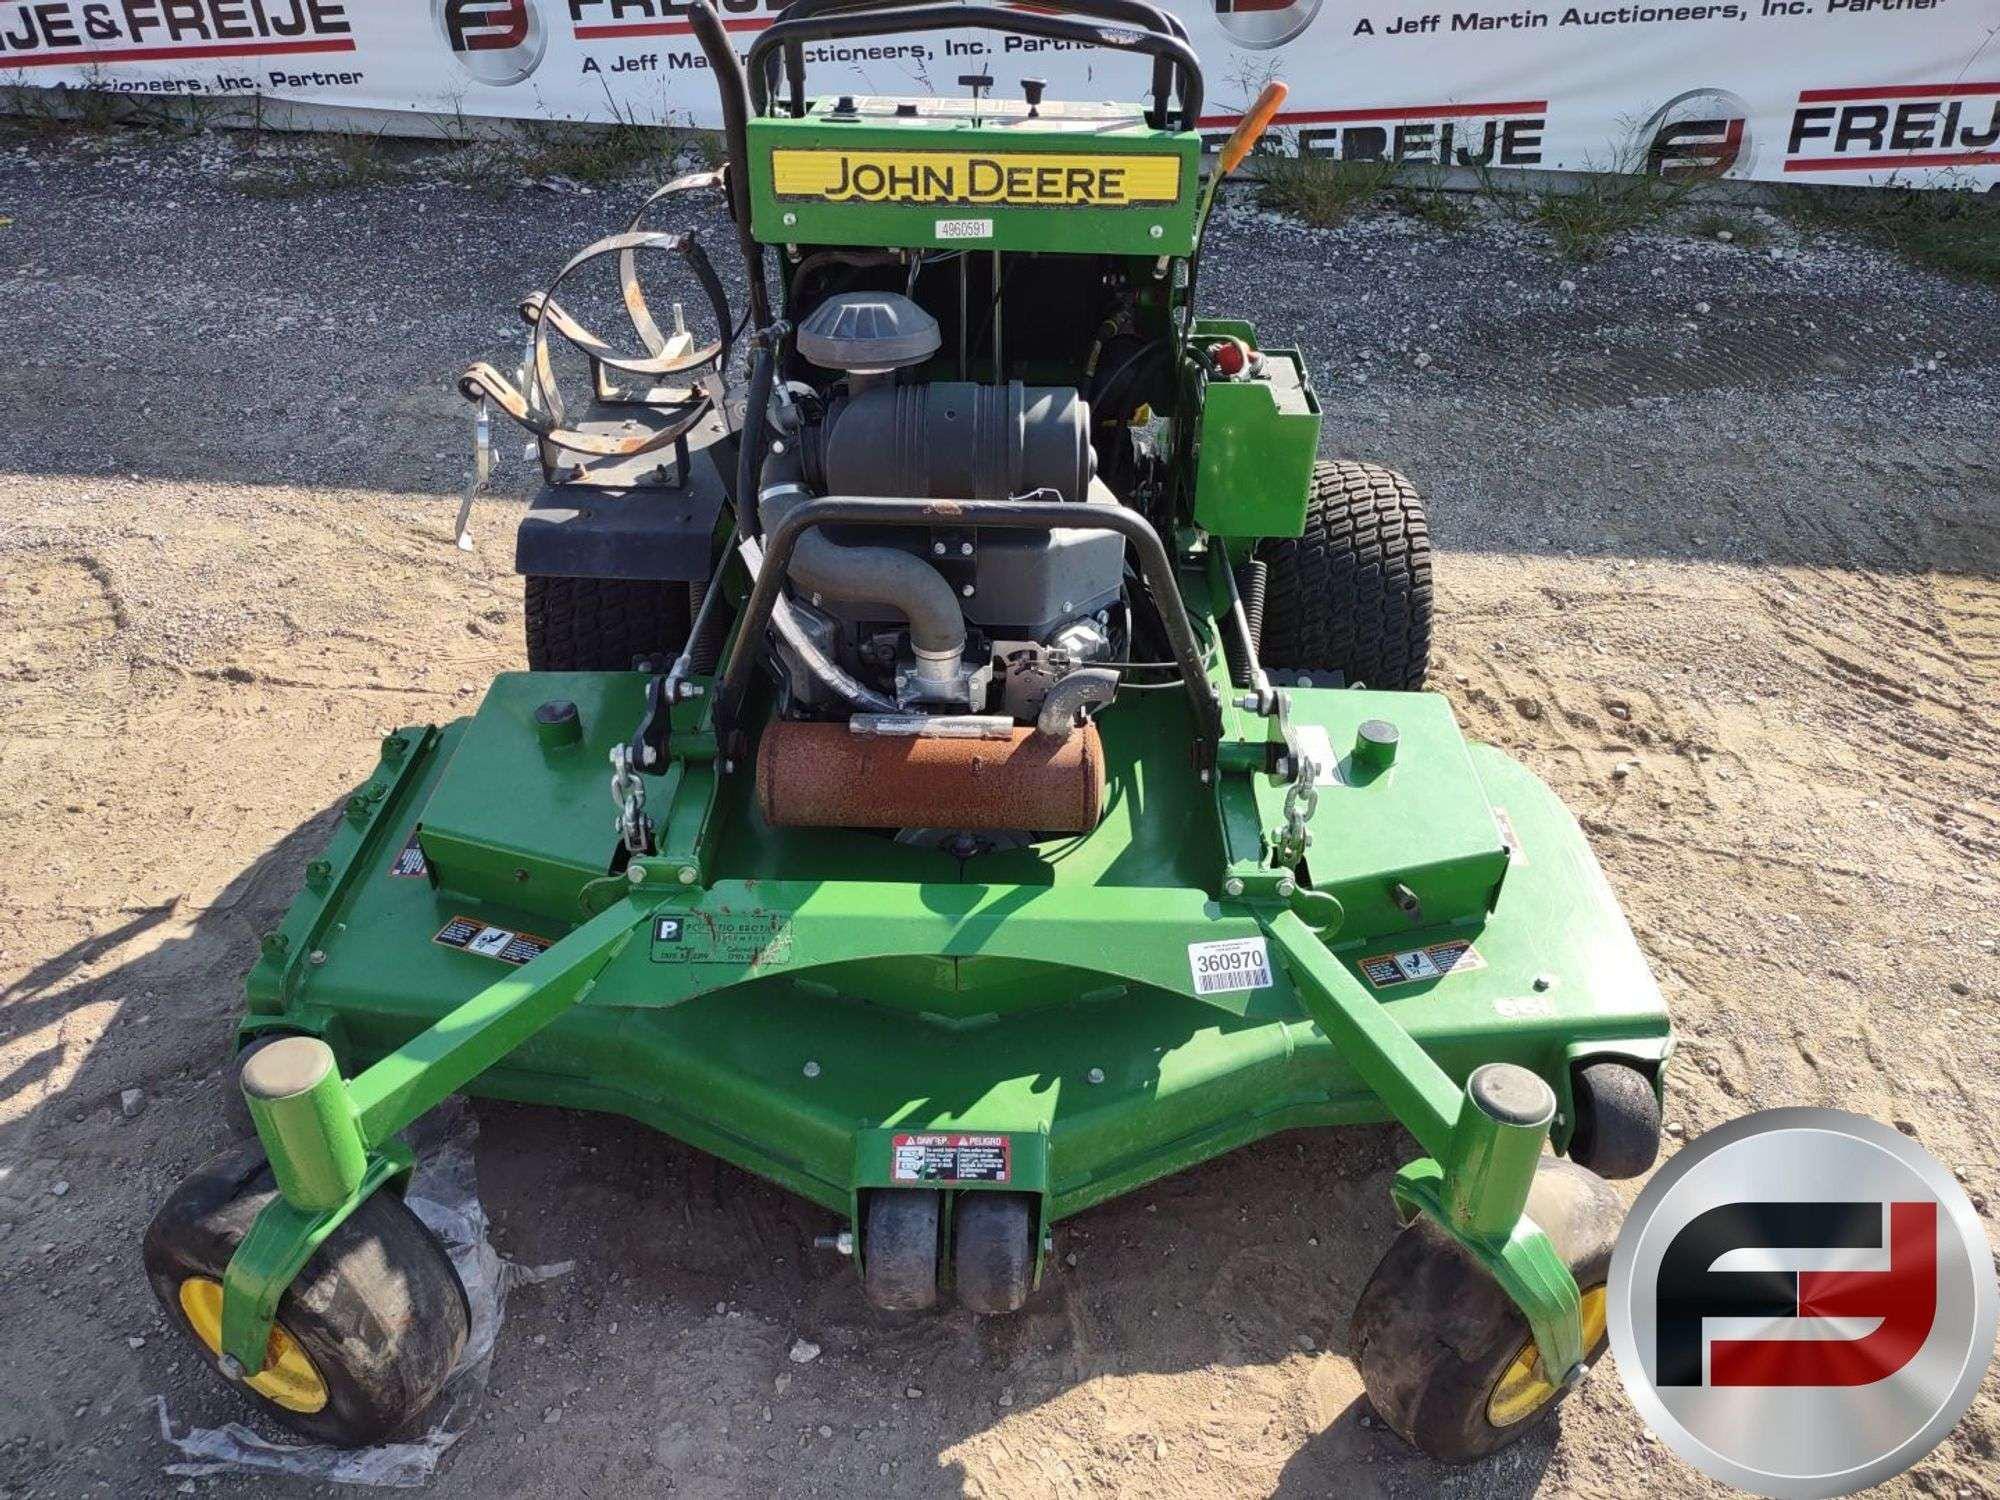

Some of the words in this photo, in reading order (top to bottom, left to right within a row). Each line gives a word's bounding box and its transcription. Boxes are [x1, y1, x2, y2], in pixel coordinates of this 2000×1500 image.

[1353, 18, 1374, 36] A
[1386, 14, 1441, 35] Jeff
[1451, 9, 1547, 32] Martin
[1559, 2, 1747, 26] Auctioneers,
[1761, 0, 1813, 16] Inc.
[582, 57, 601, 73] A
[610, 54, 659, 72] Jeff
[945, 38, 992, 56] Inc.
[217, 74, 261, 92] Inc.
[268, 71, 364, 88] Partner
[825, 157, 955, 197] JOHN
[968, 158, 1125, 199] DEERE
[1198, 950, 1263, 973] 360970
